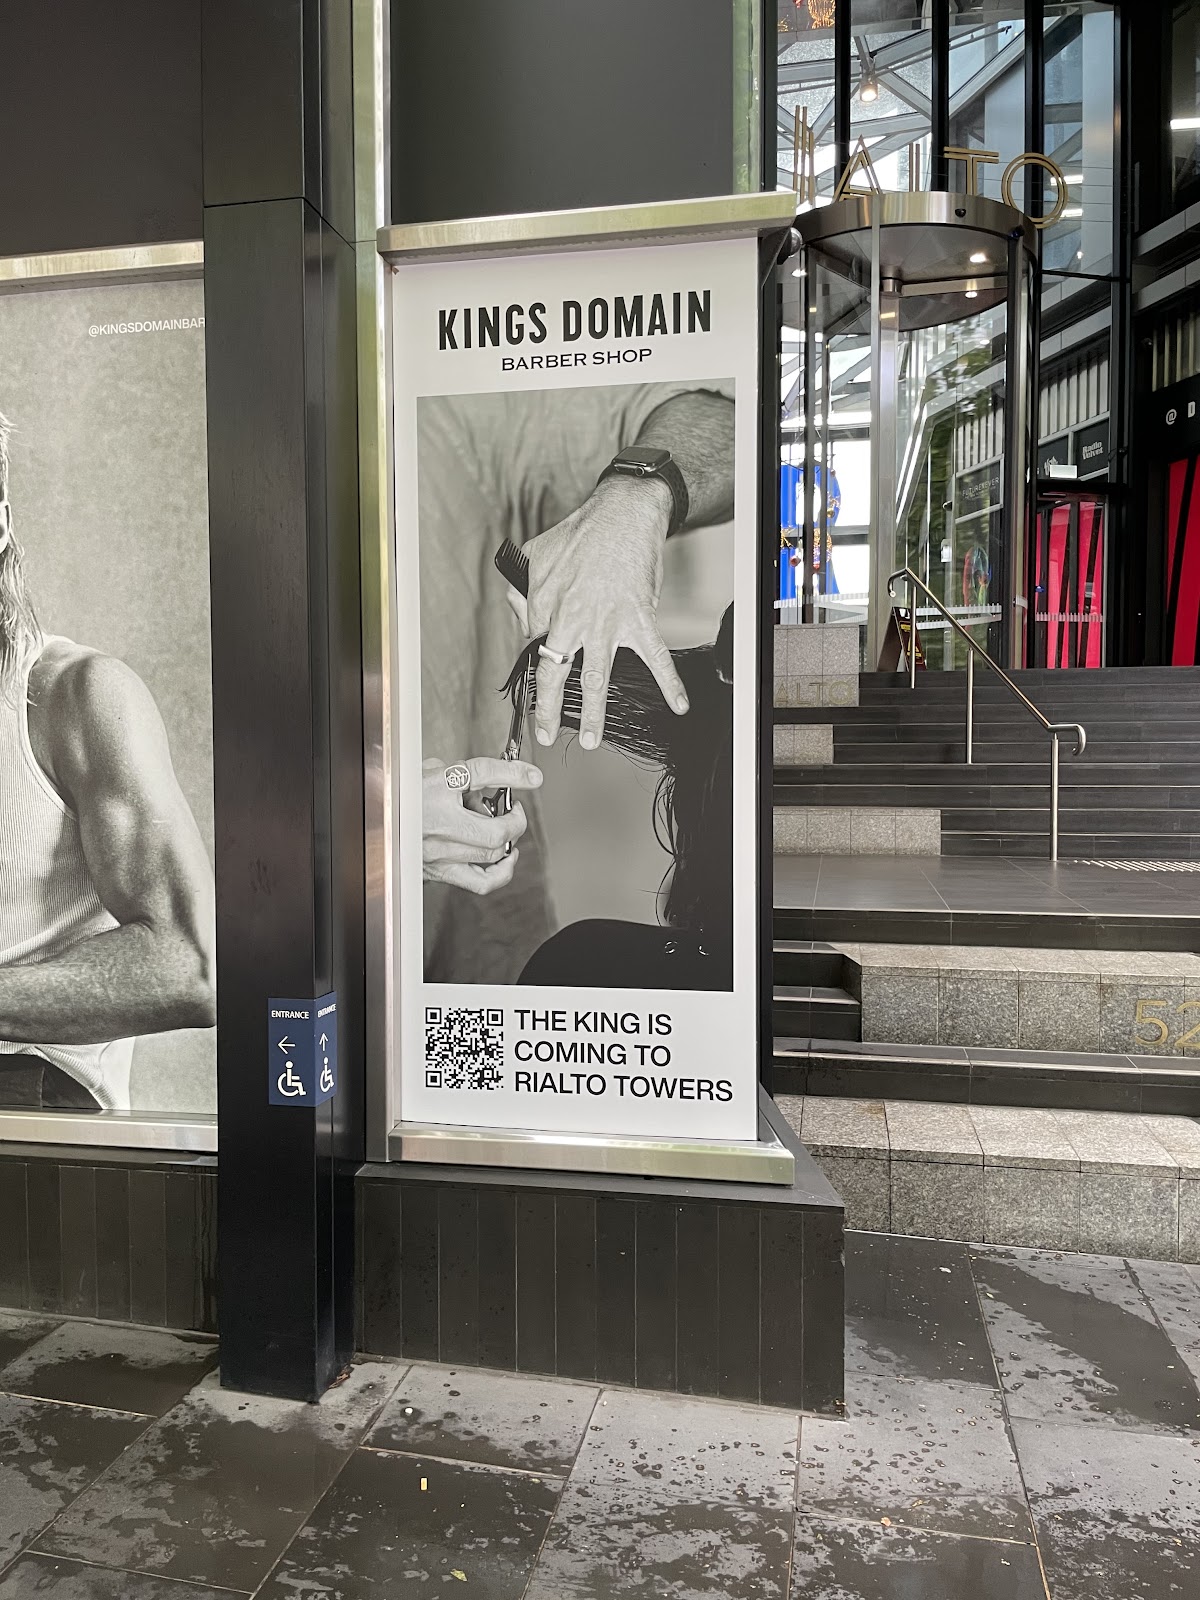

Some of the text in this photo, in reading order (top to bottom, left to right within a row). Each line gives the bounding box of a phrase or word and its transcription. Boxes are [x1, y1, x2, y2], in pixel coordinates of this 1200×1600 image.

[438, 289, 711, 351] KINGS DOMAIN
[502, 348, 653, 371] BARBER SHOP
[1082, 441, 1103, 453] Radio
[1082, 446, 1104, 460] Velvet
[271, 1009, 310, 1020] ENTRANCE
[317, 1003, 337, 1018] ENTRANCE
[513, 1009, 673, 1036] THE KING IS
[513, 1040, 672, 1067] COMING TO
[514, 1071, 734, 1102] RIALTO TOWERS
